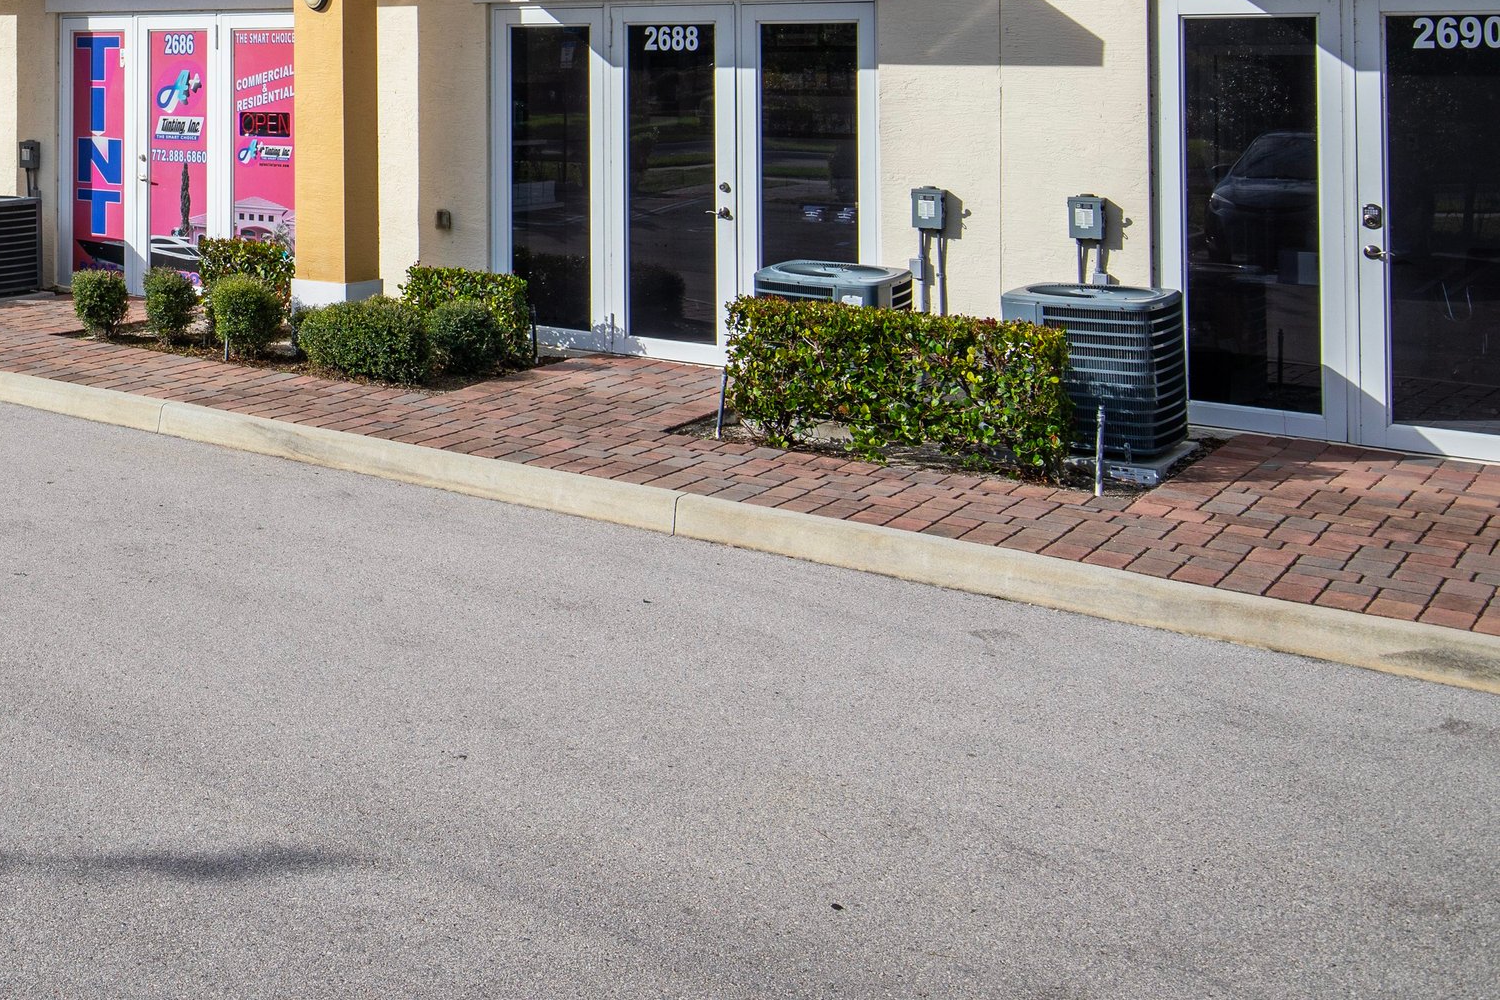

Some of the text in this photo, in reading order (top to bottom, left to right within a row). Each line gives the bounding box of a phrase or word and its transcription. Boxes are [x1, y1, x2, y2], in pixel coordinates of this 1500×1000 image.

[236, 32, 294, 43] THE SMART CHOICE
[644, 26, 699, 51] 2688
[1412, 16, 1500, 49] 2690
[164, 34, 194, 55] 2686
[236, 64, 294, 91] COMMERCIAL
[262, 83, 268, 93] &
[236, 85, 295, 112] RESIDENTIAL
[242, 113, 290, 134] OPEN
[76, 36, 123, 236] TINT
[152, 149, 206, 163] 772.888.6860
